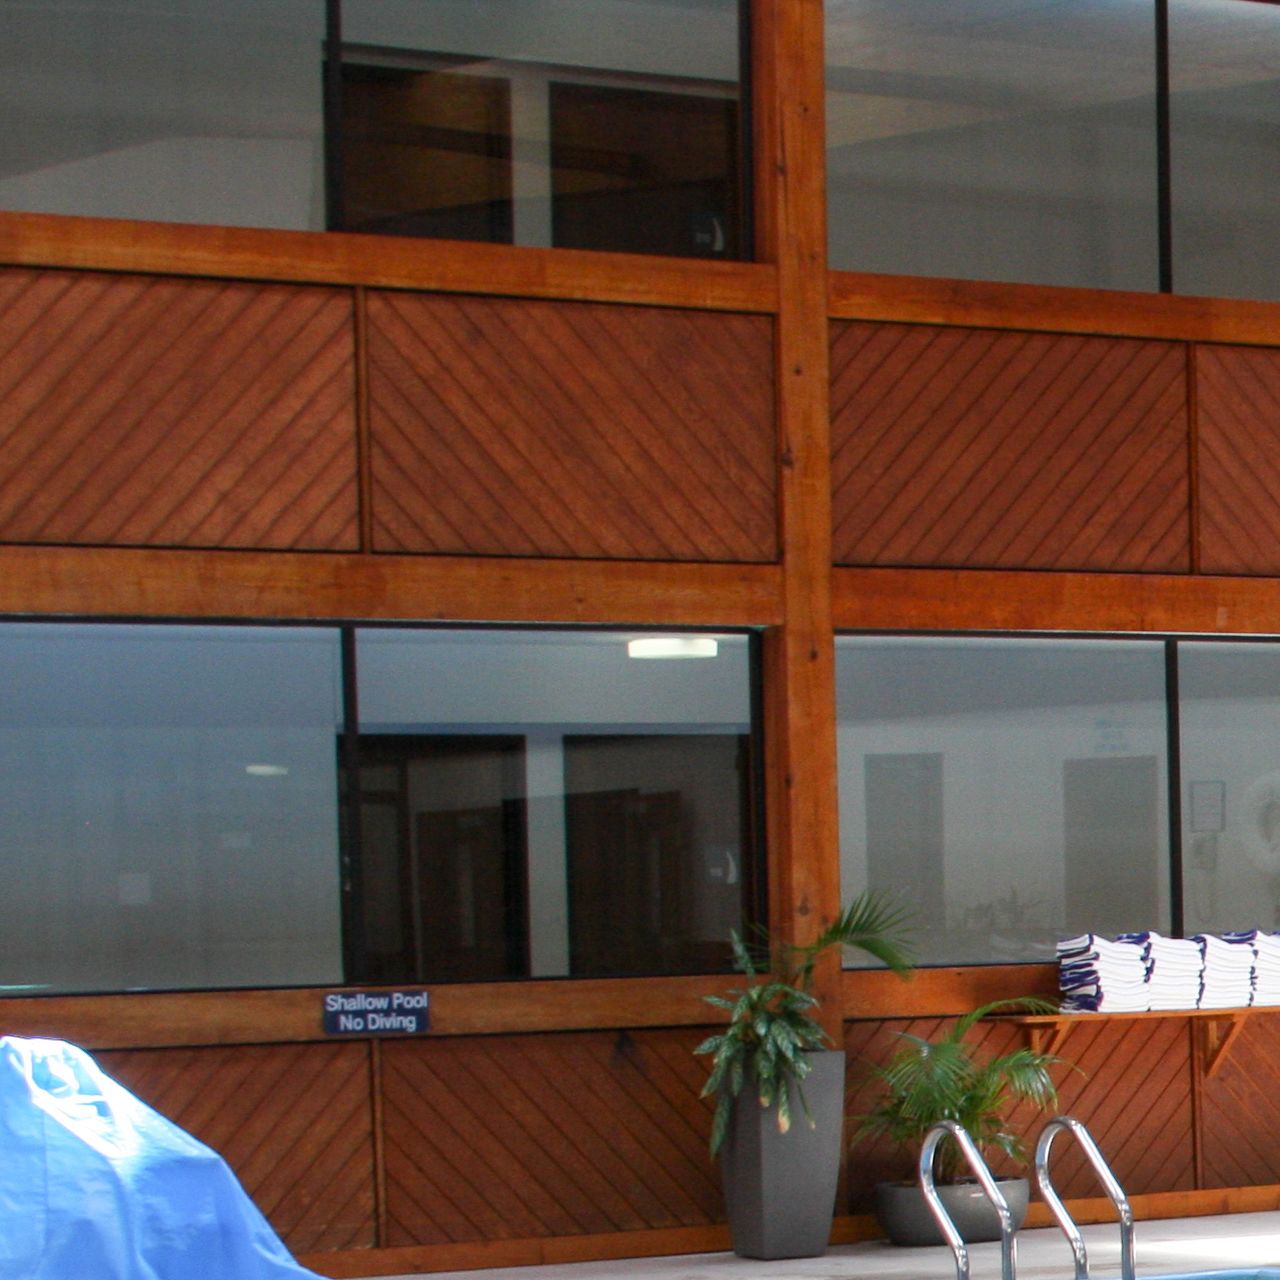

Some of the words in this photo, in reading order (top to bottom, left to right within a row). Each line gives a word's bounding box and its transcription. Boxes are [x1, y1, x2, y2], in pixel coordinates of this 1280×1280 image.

[326, 994, 389, 1011] Shallow
[392, 992, 428, 1009] Pool
[339, 1014, 364, 1030] No
[368, 1013, 416, 1032] Diving
